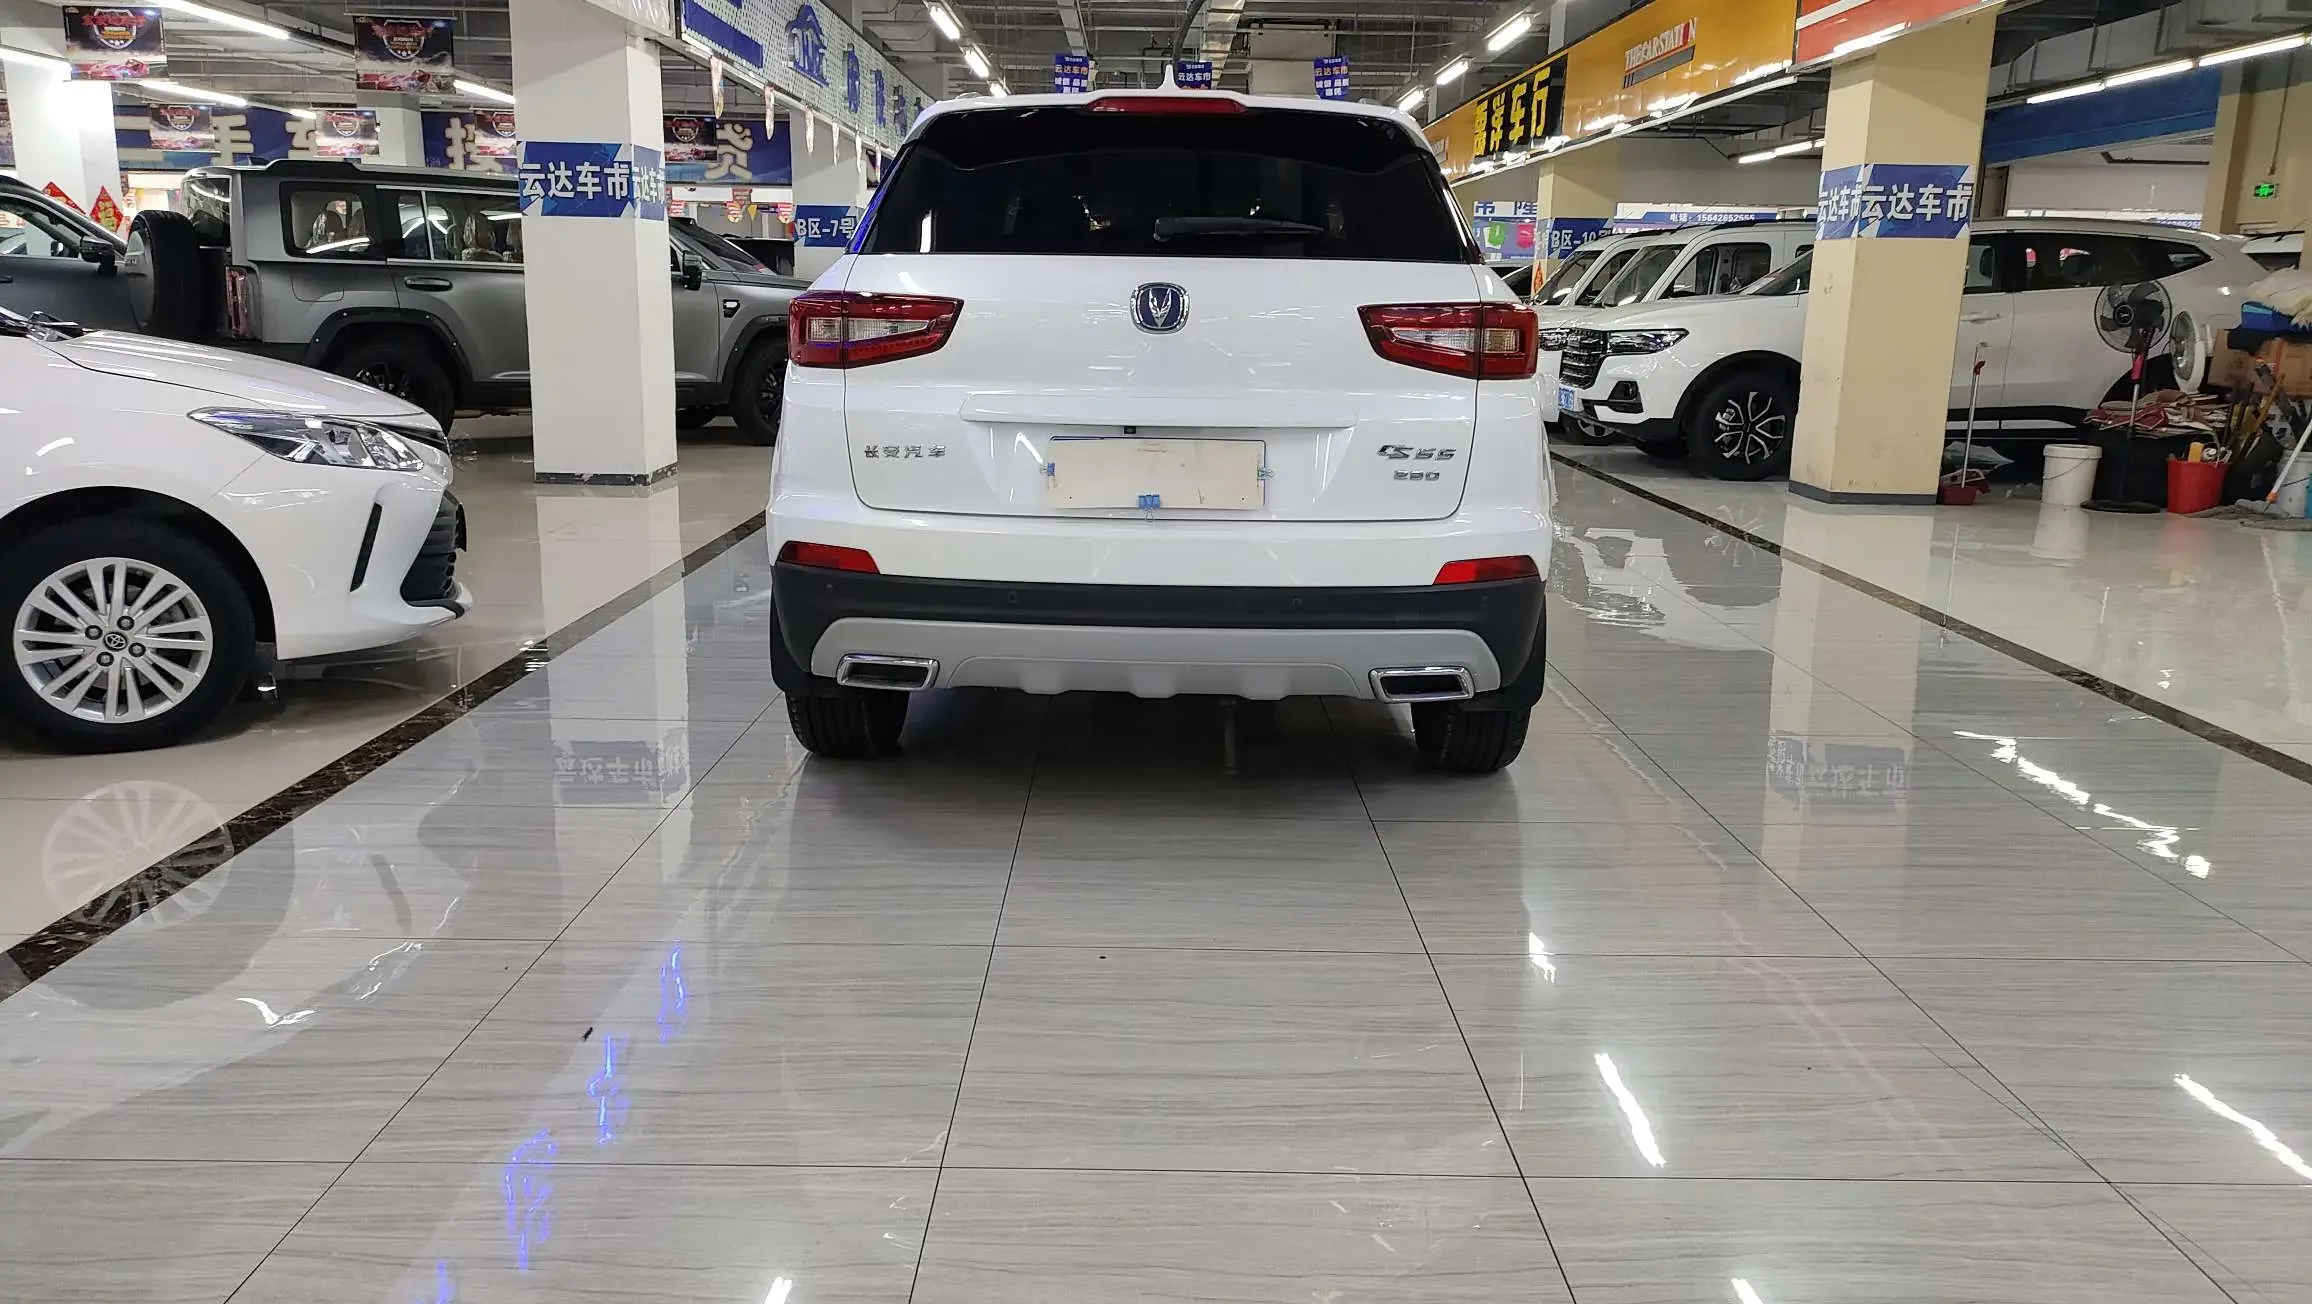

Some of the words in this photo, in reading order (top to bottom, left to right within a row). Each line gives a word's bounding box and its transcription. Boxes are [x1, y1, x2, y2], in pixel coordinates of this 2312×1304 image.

[1178, 72, 1211, 81] 云达车市
[519, 161, 630, 200] 云达车市
[1818, 184, 1862, 222] 云达车市
[1861, 183, 1973, 222] 云达车市
[795, 217, 855, 239] B区-7号
